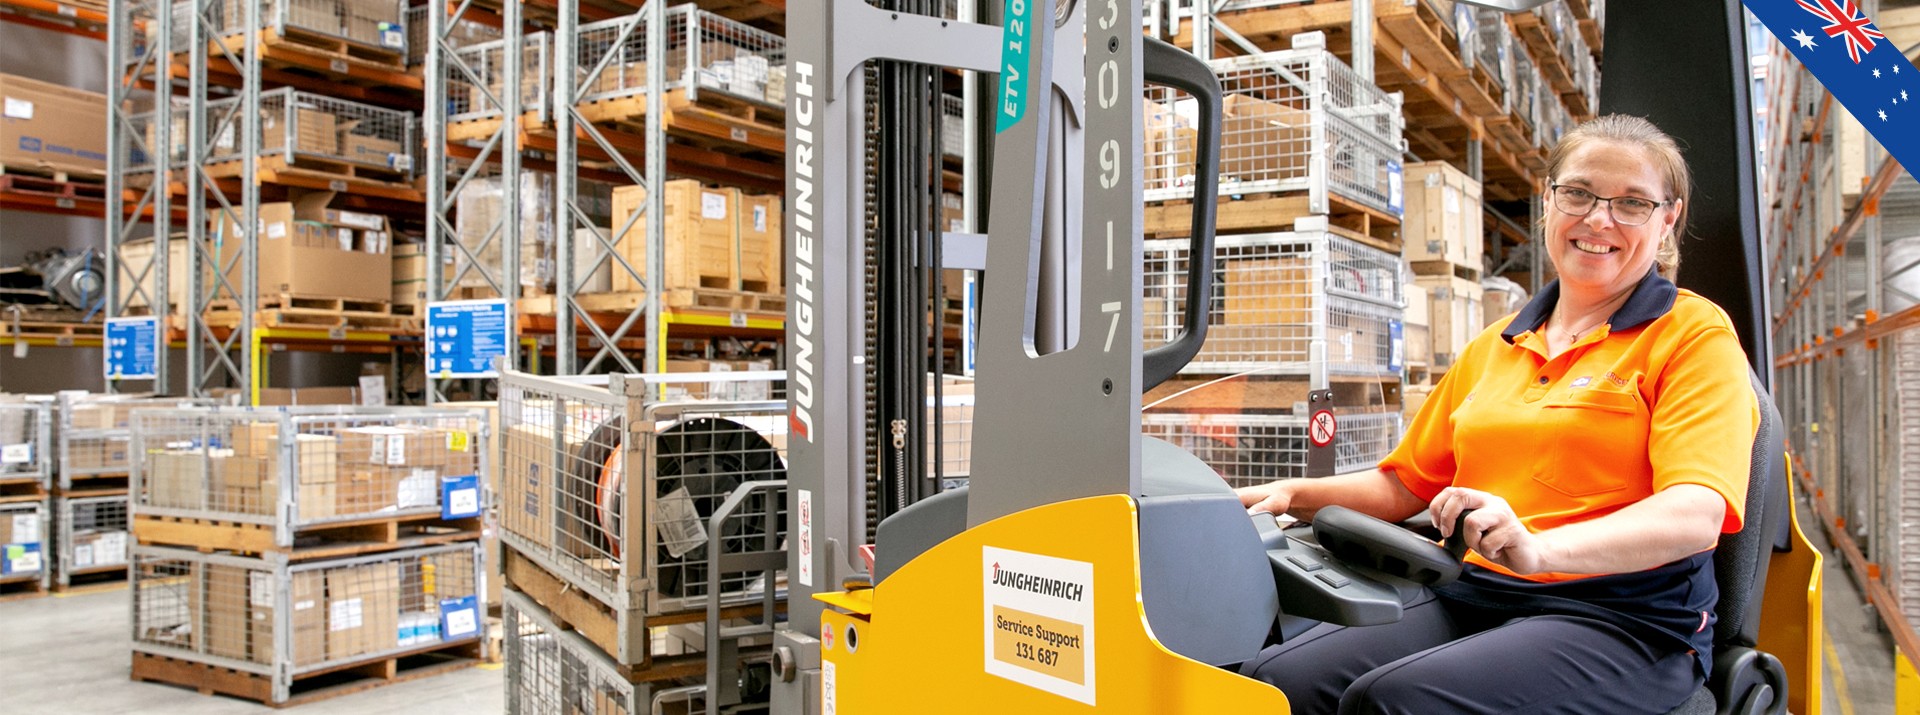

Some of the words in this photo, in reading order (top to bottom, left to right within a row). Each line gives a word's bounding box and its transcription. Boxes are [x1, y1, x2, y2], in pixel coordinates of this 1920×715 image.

[1009, 0, 1026, 54] 120
[1004, 64, 1020, 118] ETV
[795, 61, 814, 444] JUNGHEINRICH
[992, 568, 1084, 602] JUNGHEINRICH
[996, 614, 1034, 637] Service
[1035, 624, 1080, 649] Support
[1016, 641, 1035, 661] 131
[1037, 647, 1059, 667] 687
